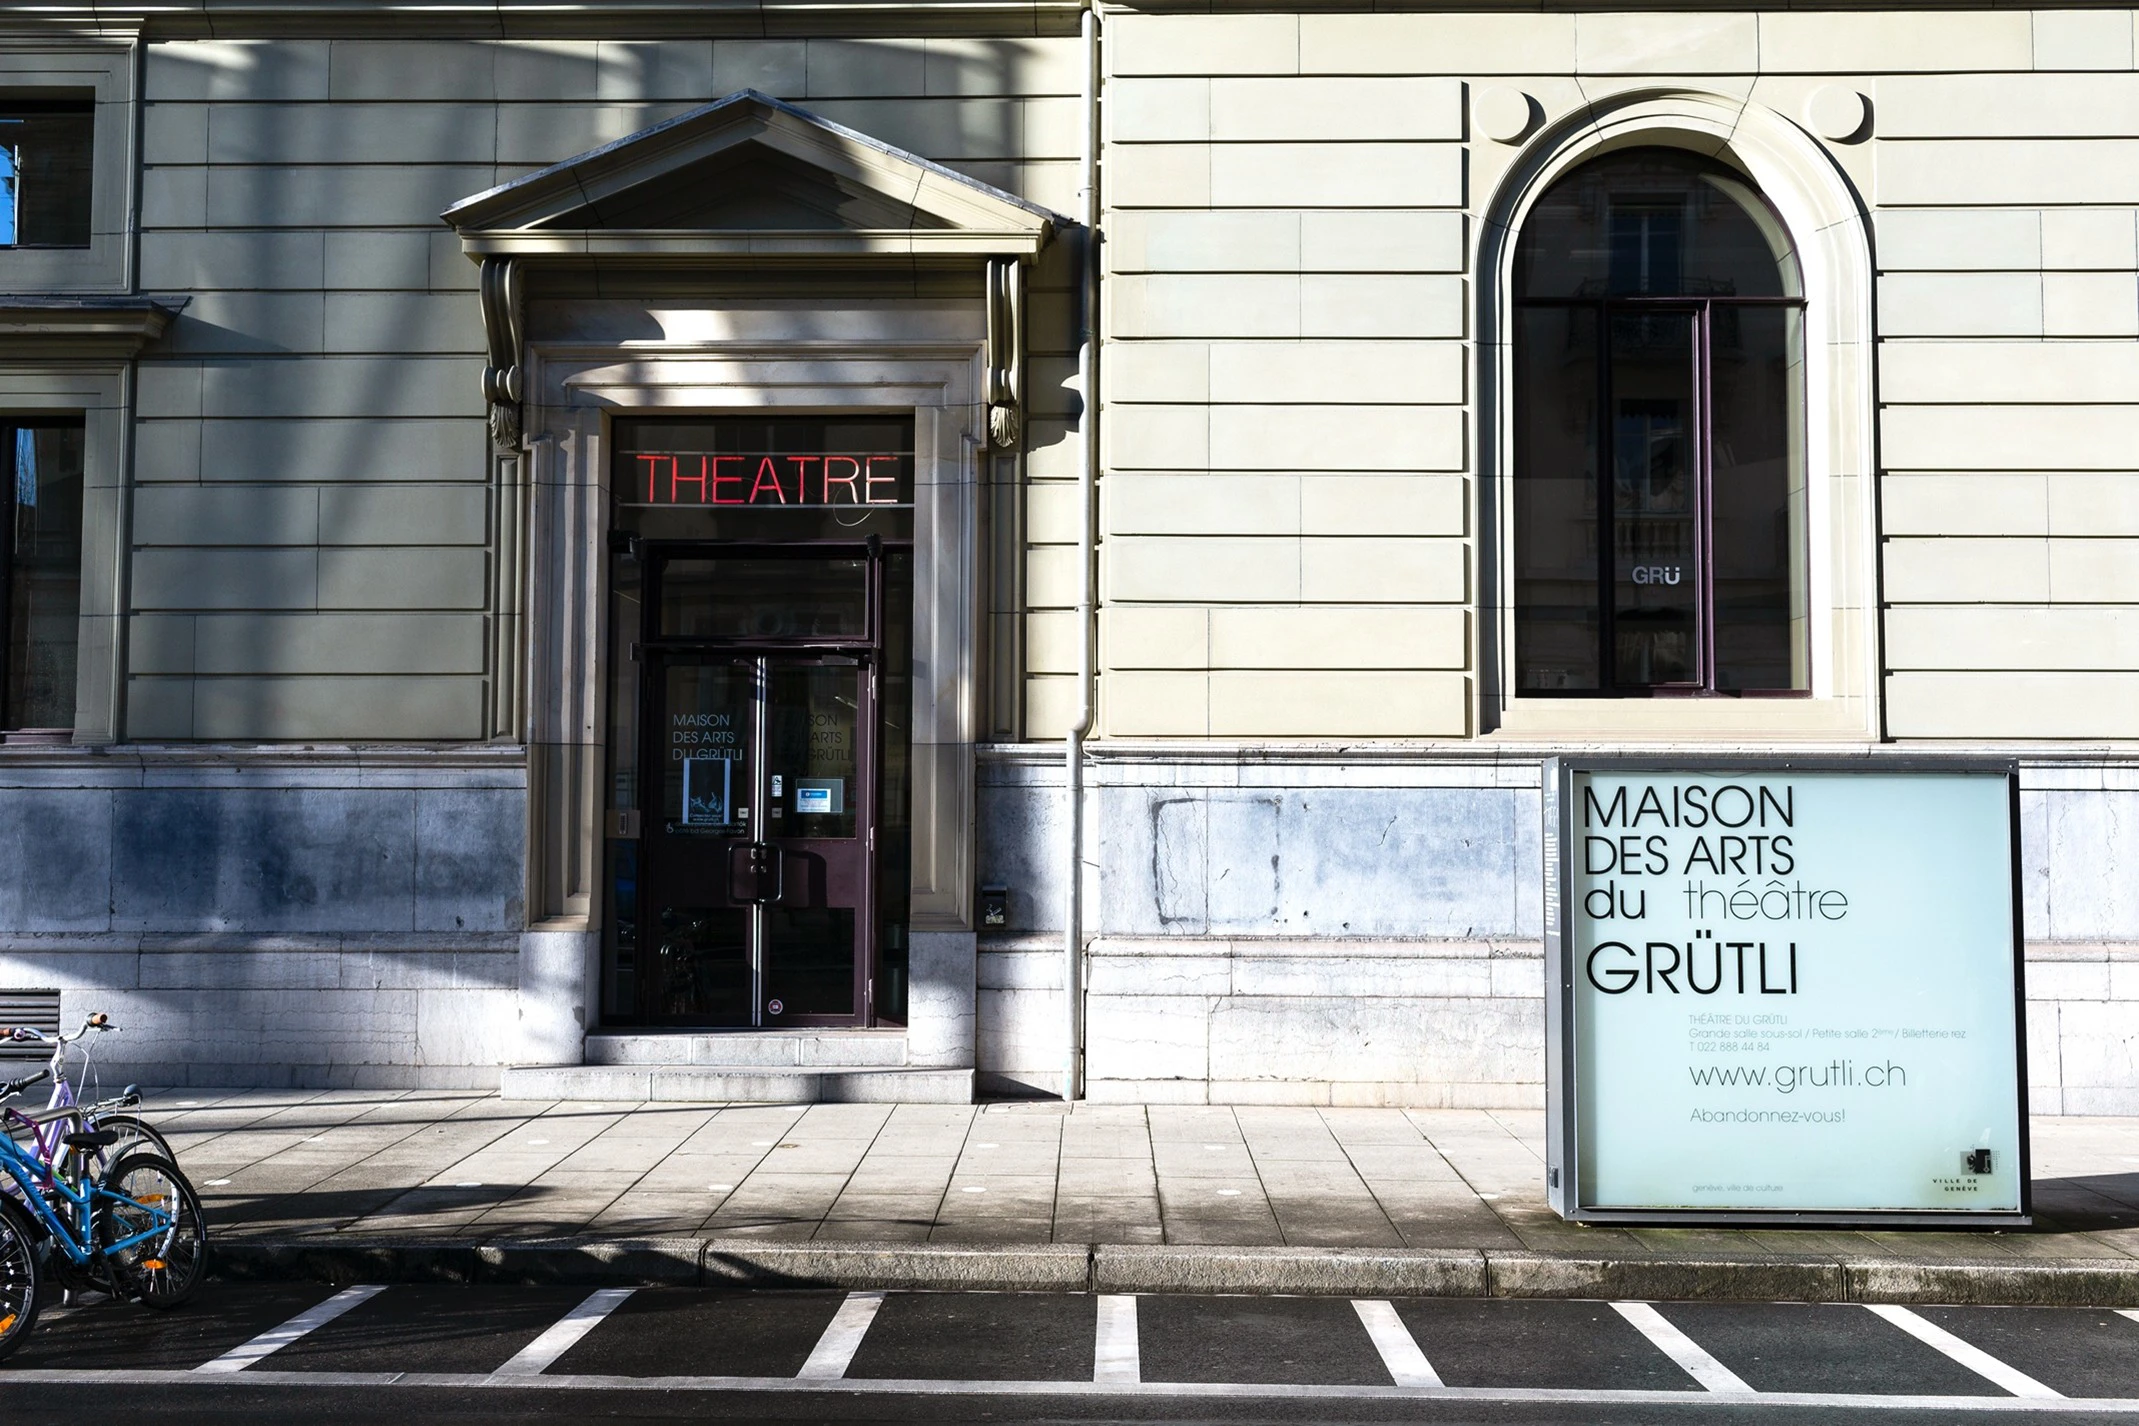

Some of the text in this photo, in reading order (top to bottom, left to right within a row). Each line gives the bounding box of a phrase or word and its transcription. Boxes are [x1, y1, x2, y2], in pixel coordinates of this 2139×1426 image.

[636, 455, 899, 505] THEATRE
[1632, 566, 1681, 585] GRÜ
[673, 713, 730, 727] MAISON
[673, 731, 735, 744] DES ARTS
[810, 731, 842, 744] ARTS
[673, 746, 743, 761] DU GRÜTLI
[1584, 784, 1794, 829] MAISON
[1584, 834, 1795, 876] DES ARTS
[1584, 879, 1849, 921] du théâtre
[1585, 929, 1798, 995] GRÜTLI
[1689, 1012, 1788, 1025] THÉÂTRE DU GRÜTLI
[1688, 1028, 1731, 1039] Grande
[1733, 1028, 1758, 1039] salle
[1761, 1028, 1803, 1039] sous-sol
[1812, 1028, 1842, 1039] Petite
[1844, 1028, 1869, 1039] salle
[1902, 1028, 1949, 1039] Billetterie
[1950, 1028, 1967, 1039] rez
[1689, 1042, 1770, 1052] T 022 888 44 84
[1688, 1059, 1906, 1095] www.grutli.ch
[1690, 1108, 1846, 1123] Abandonnez-vous!
